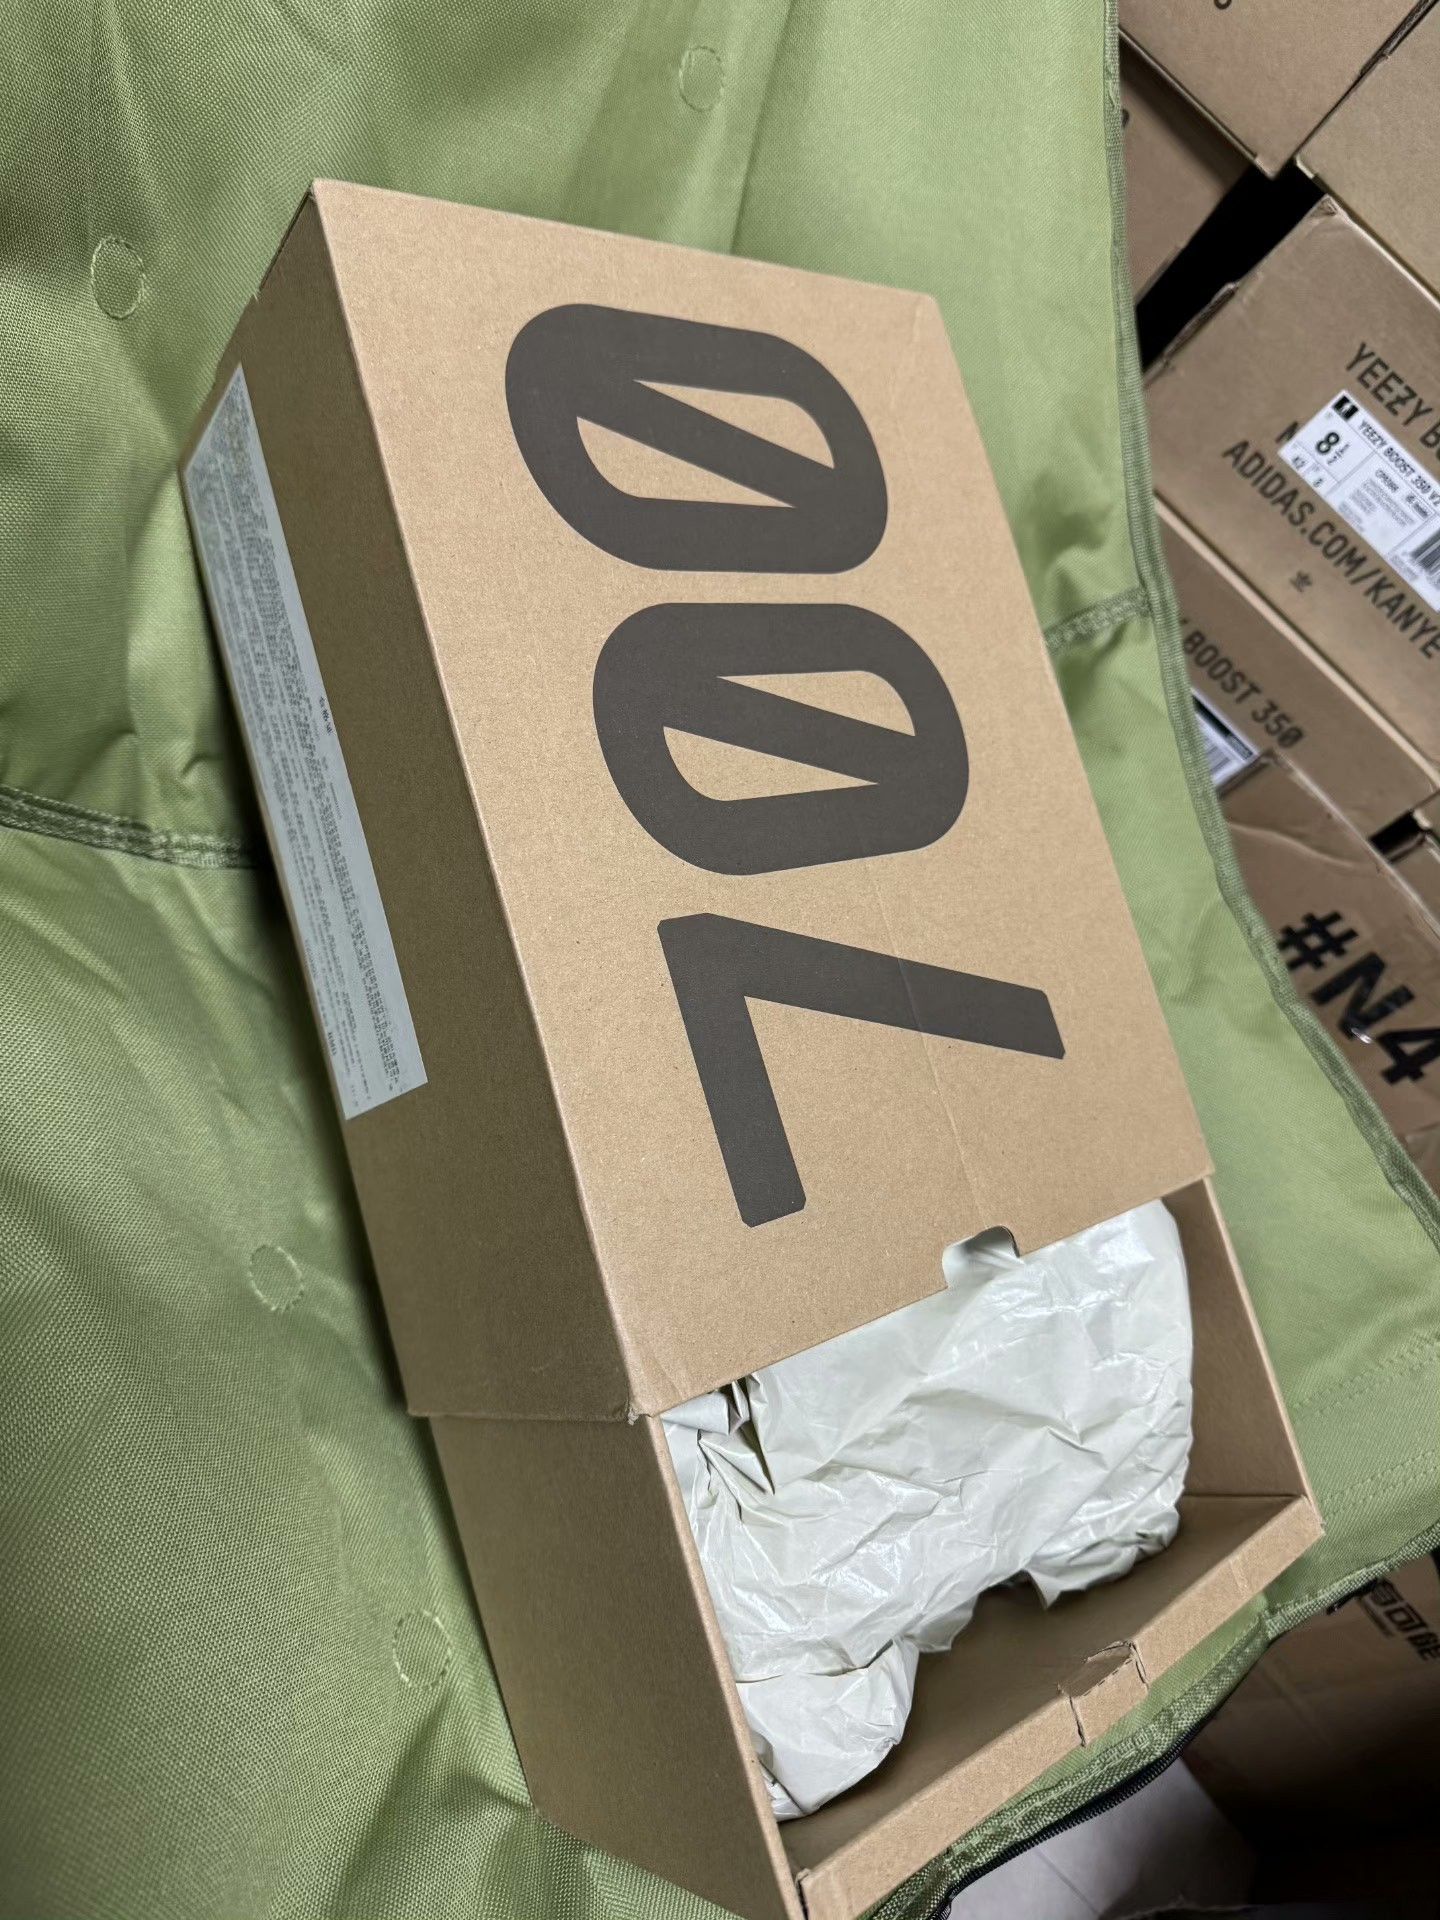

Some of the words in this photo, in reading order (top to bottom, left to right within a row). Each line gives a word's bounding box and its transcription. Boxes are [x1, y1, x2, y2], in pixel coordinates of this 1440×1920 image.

[1345, 341, 1434, 426] YEEZY
[1315, 432, 1340, 455] 8
[1359, 420, 1388, 449] YEEZY
[1383, 447, 1416, 477] BOOST
[1182, 630, 1261, 703] BOOST
[1250, 700, 1305, 749] 350
[505, 303, 1065, 1228] 700
